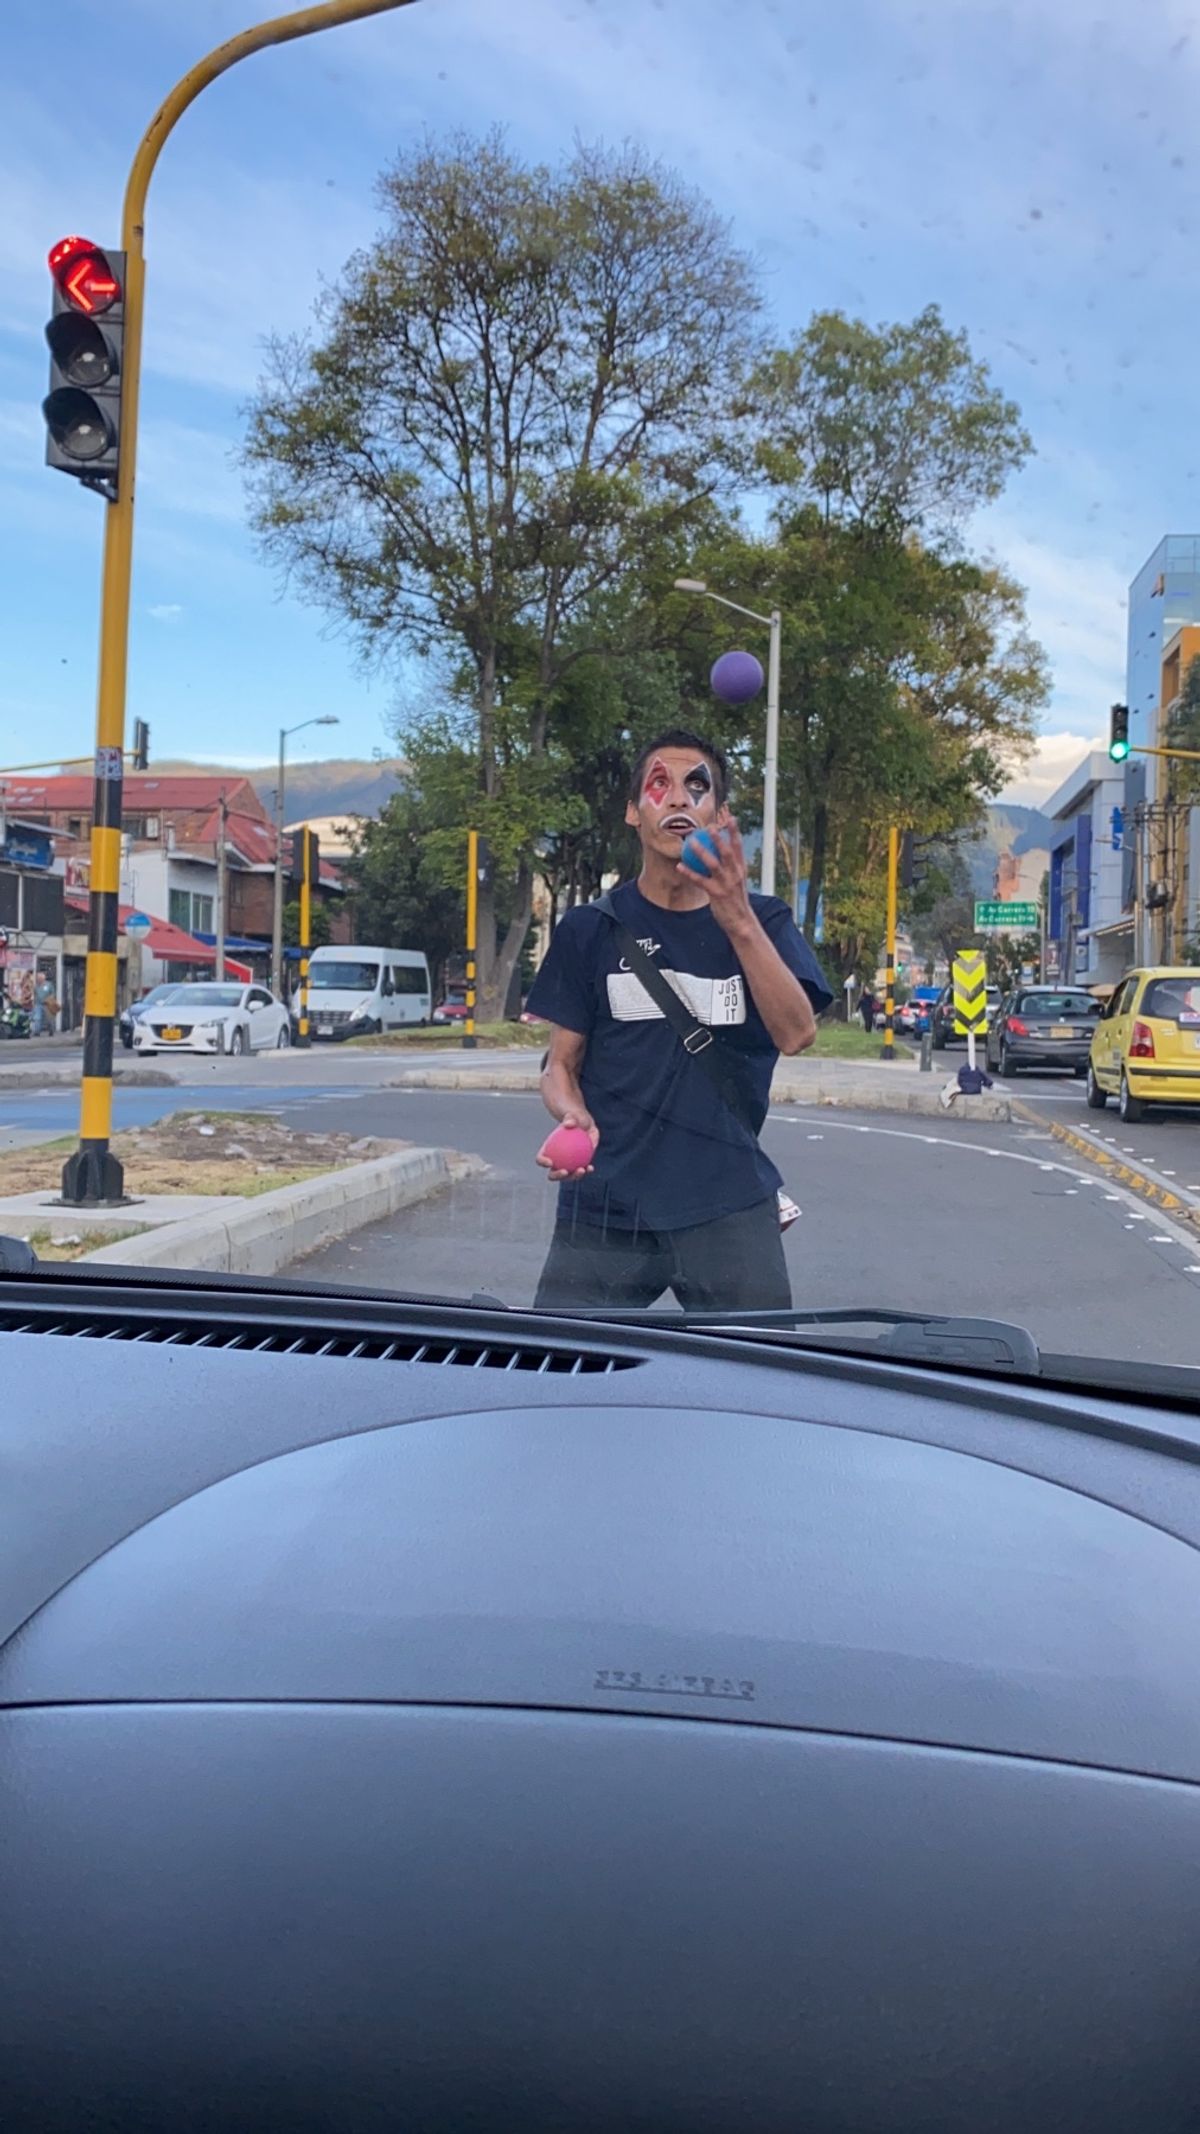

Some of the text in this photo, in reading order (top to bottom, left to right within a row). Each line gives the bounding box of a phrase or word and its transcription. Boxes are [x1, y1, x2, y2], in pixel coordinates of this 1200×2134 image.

[718, 978, 743, 995] JUST
[724, 993, 738, 1007] DO
[726, 1008, 737, 1022] IT
